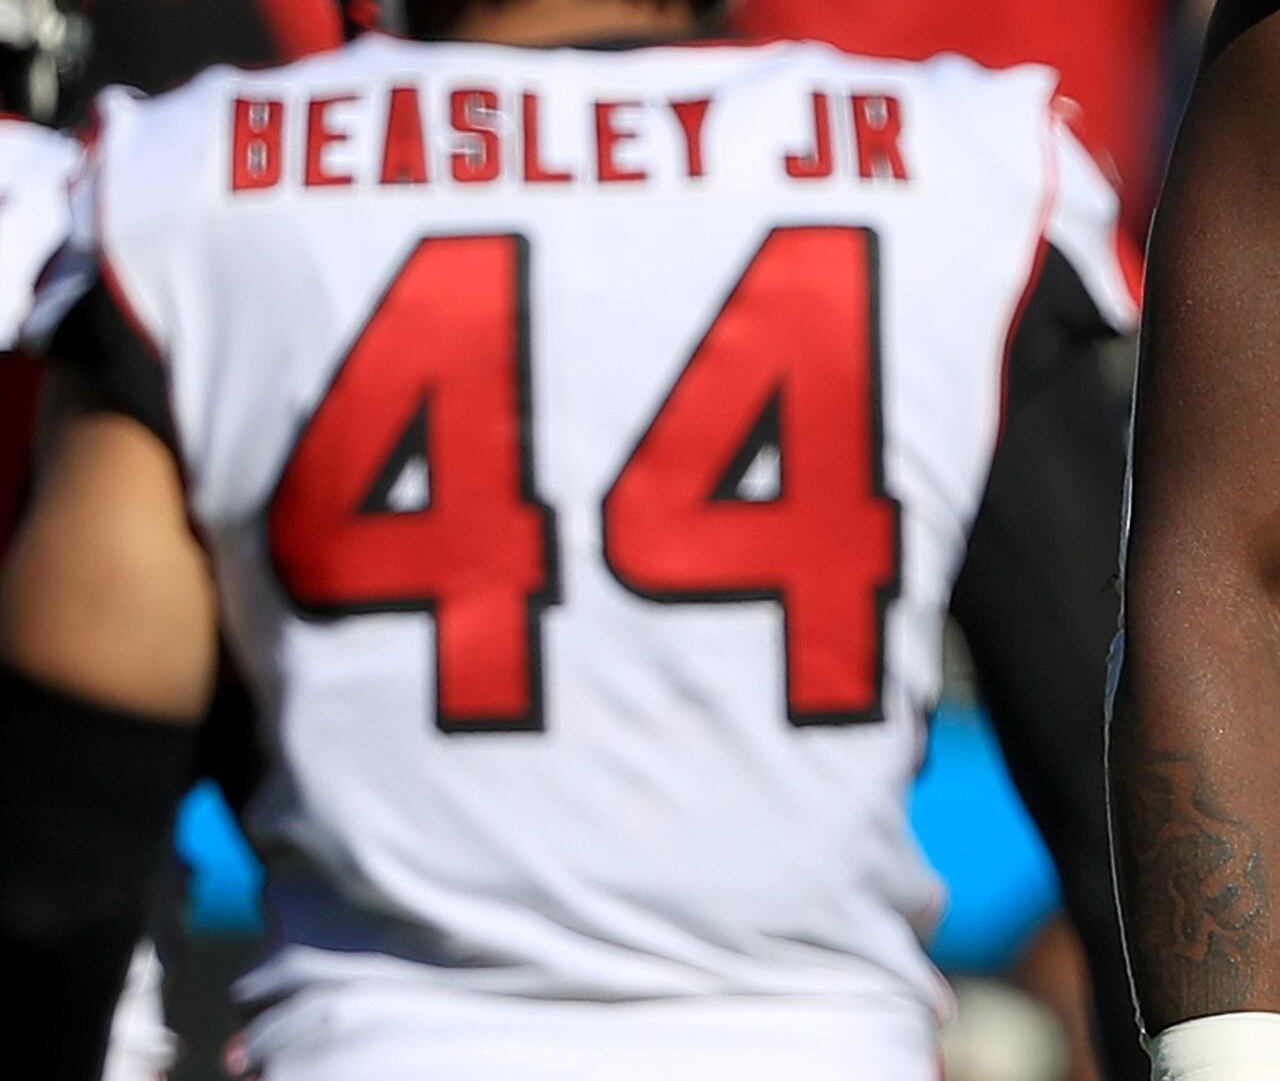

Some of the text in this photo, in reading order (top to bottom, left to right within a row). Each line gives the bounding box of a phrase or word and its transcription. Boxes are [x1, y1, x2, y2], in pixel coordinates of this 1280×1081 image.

[230, 86, 911, 192] BEASLEY JR
[265, 224, 904, 734] 44
